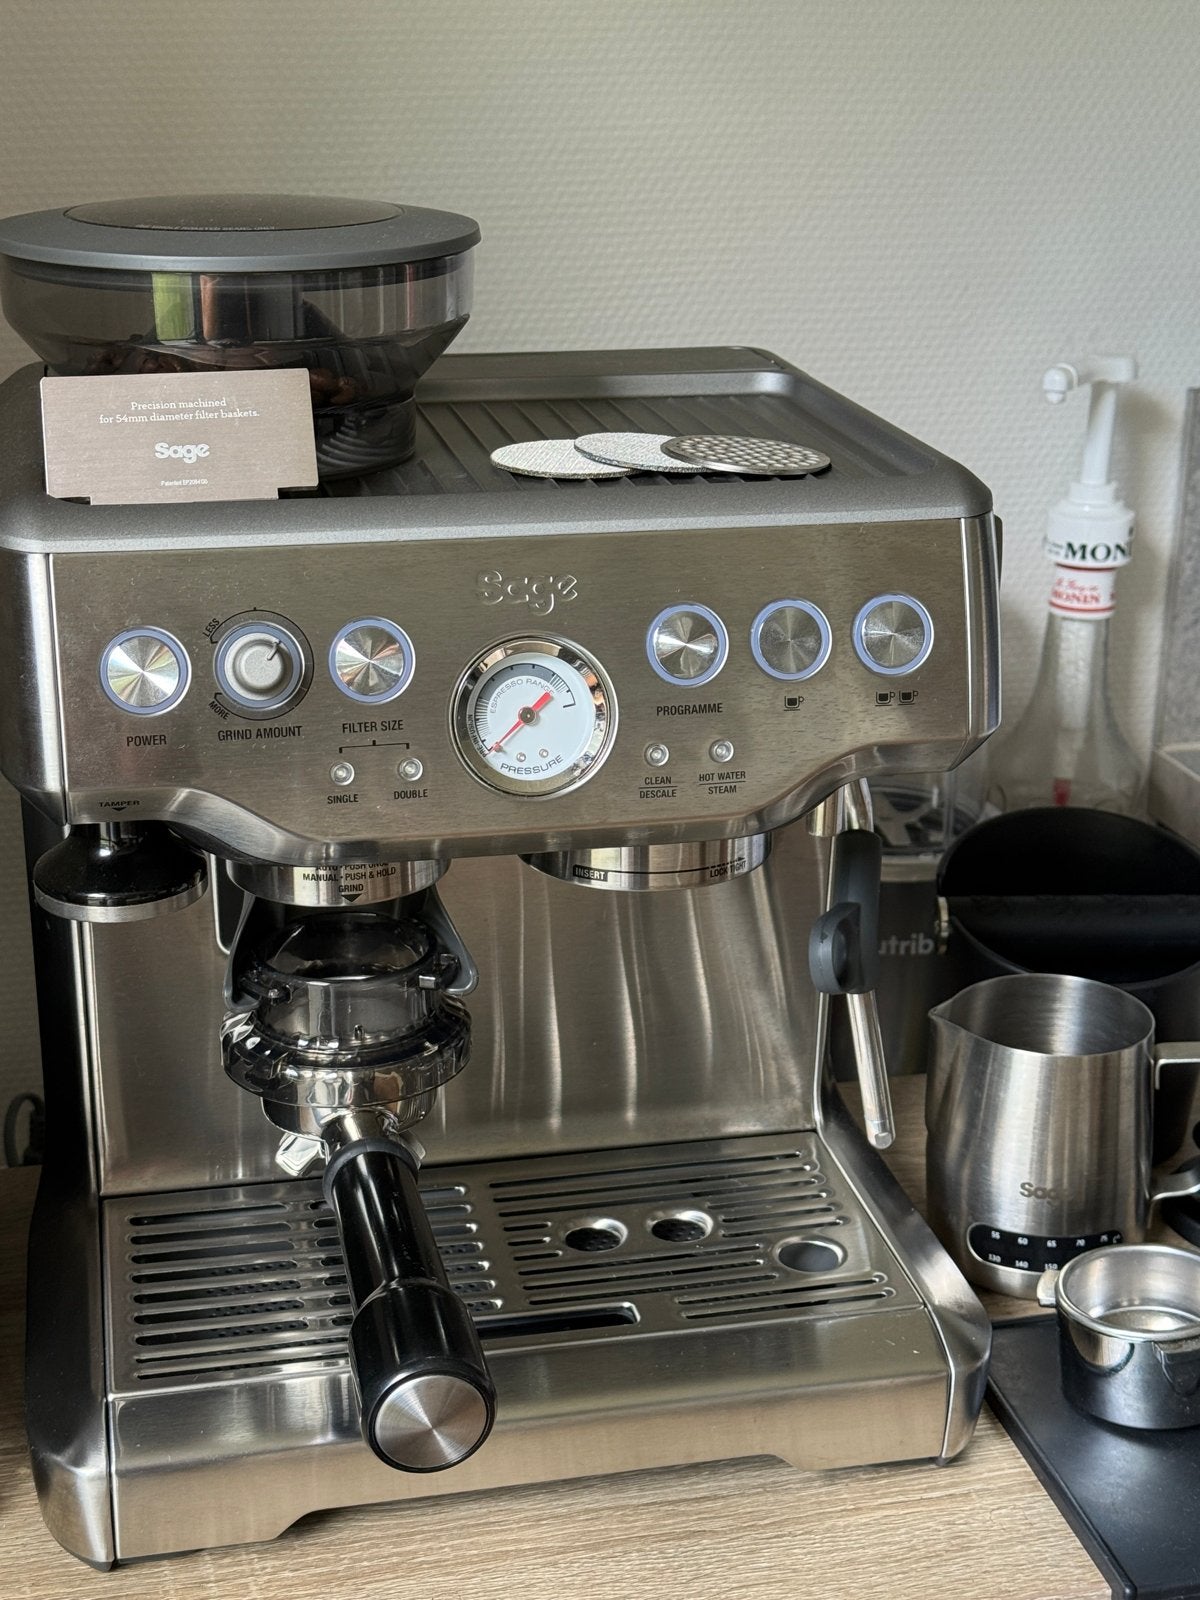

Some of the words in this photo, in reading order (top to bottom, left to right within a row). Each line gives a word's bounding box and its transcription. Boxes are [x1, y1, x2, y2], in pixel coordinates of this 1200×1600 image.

[130, 401, 177, 410] Precision
[178, 398, 227, 409] machined
[99, 414, 114, 424] for
[115, 413, 148, 423] 54mm
[149, 411, 194, 422] diameter
[194, 408, 219, 419] filter
[220, 407, 260, 418] baskets.
[154, 442, 210, 464] Sage
[476, 569, 579, 616] Sage
[202, 617, 221, 638] LESS
[489, 678, 524, 714] ESPRESSO
[525, 678, 555, 695] RANGE
[208, 700, 231, 720] MORE
[656, 702, 723, 717] PROGRAMME
[217, 729, 252, 742] GRIND
[254, 725, 303, 740] AMOUNT
[341, 721, 378, 734] FILTER
[380, 719, 404, 732] SIZE
[126, 734, 167, 747] POWER
[500, 754, 564, 775] PRESSURE
[643, 776, 672, 786] CLEAN
[698, 773, 716, 782] HOT
[717, 770, 746, 781] WATER
[393, 788, 428, 801] DOUBLE
[639, 788, 677, 799] DESCALE
[707, 785, 737, 796] STEAM
[98, 800, 140, 808] TAMPER
[326, 793, 359, 804] SINGLE
[302, 873, 339, 882] MANUAL
[345, 872, 366, 881] PUSH
[368, 870, 374, 879] &
[376, 866, 396, 878] HOLD
[344, 863, 366, 871] PUSH
[575, 866, 606, 881] INSERT
[709, 868, 727, 878] LOCK
[729, 861, 747, 875] TIGHT
[338, 883, 364, 893] GRIND
[991, 1231, 1000, 1240] 55
[1017, 1236, 1029, 1246] 60
[1046, 1239, 1057, 1248] 65
[1075, 1238, 1086, 1247] 70
[988, 1253, 1001, 1263] 130
[1015, 1259, 1029, 1269] 140
